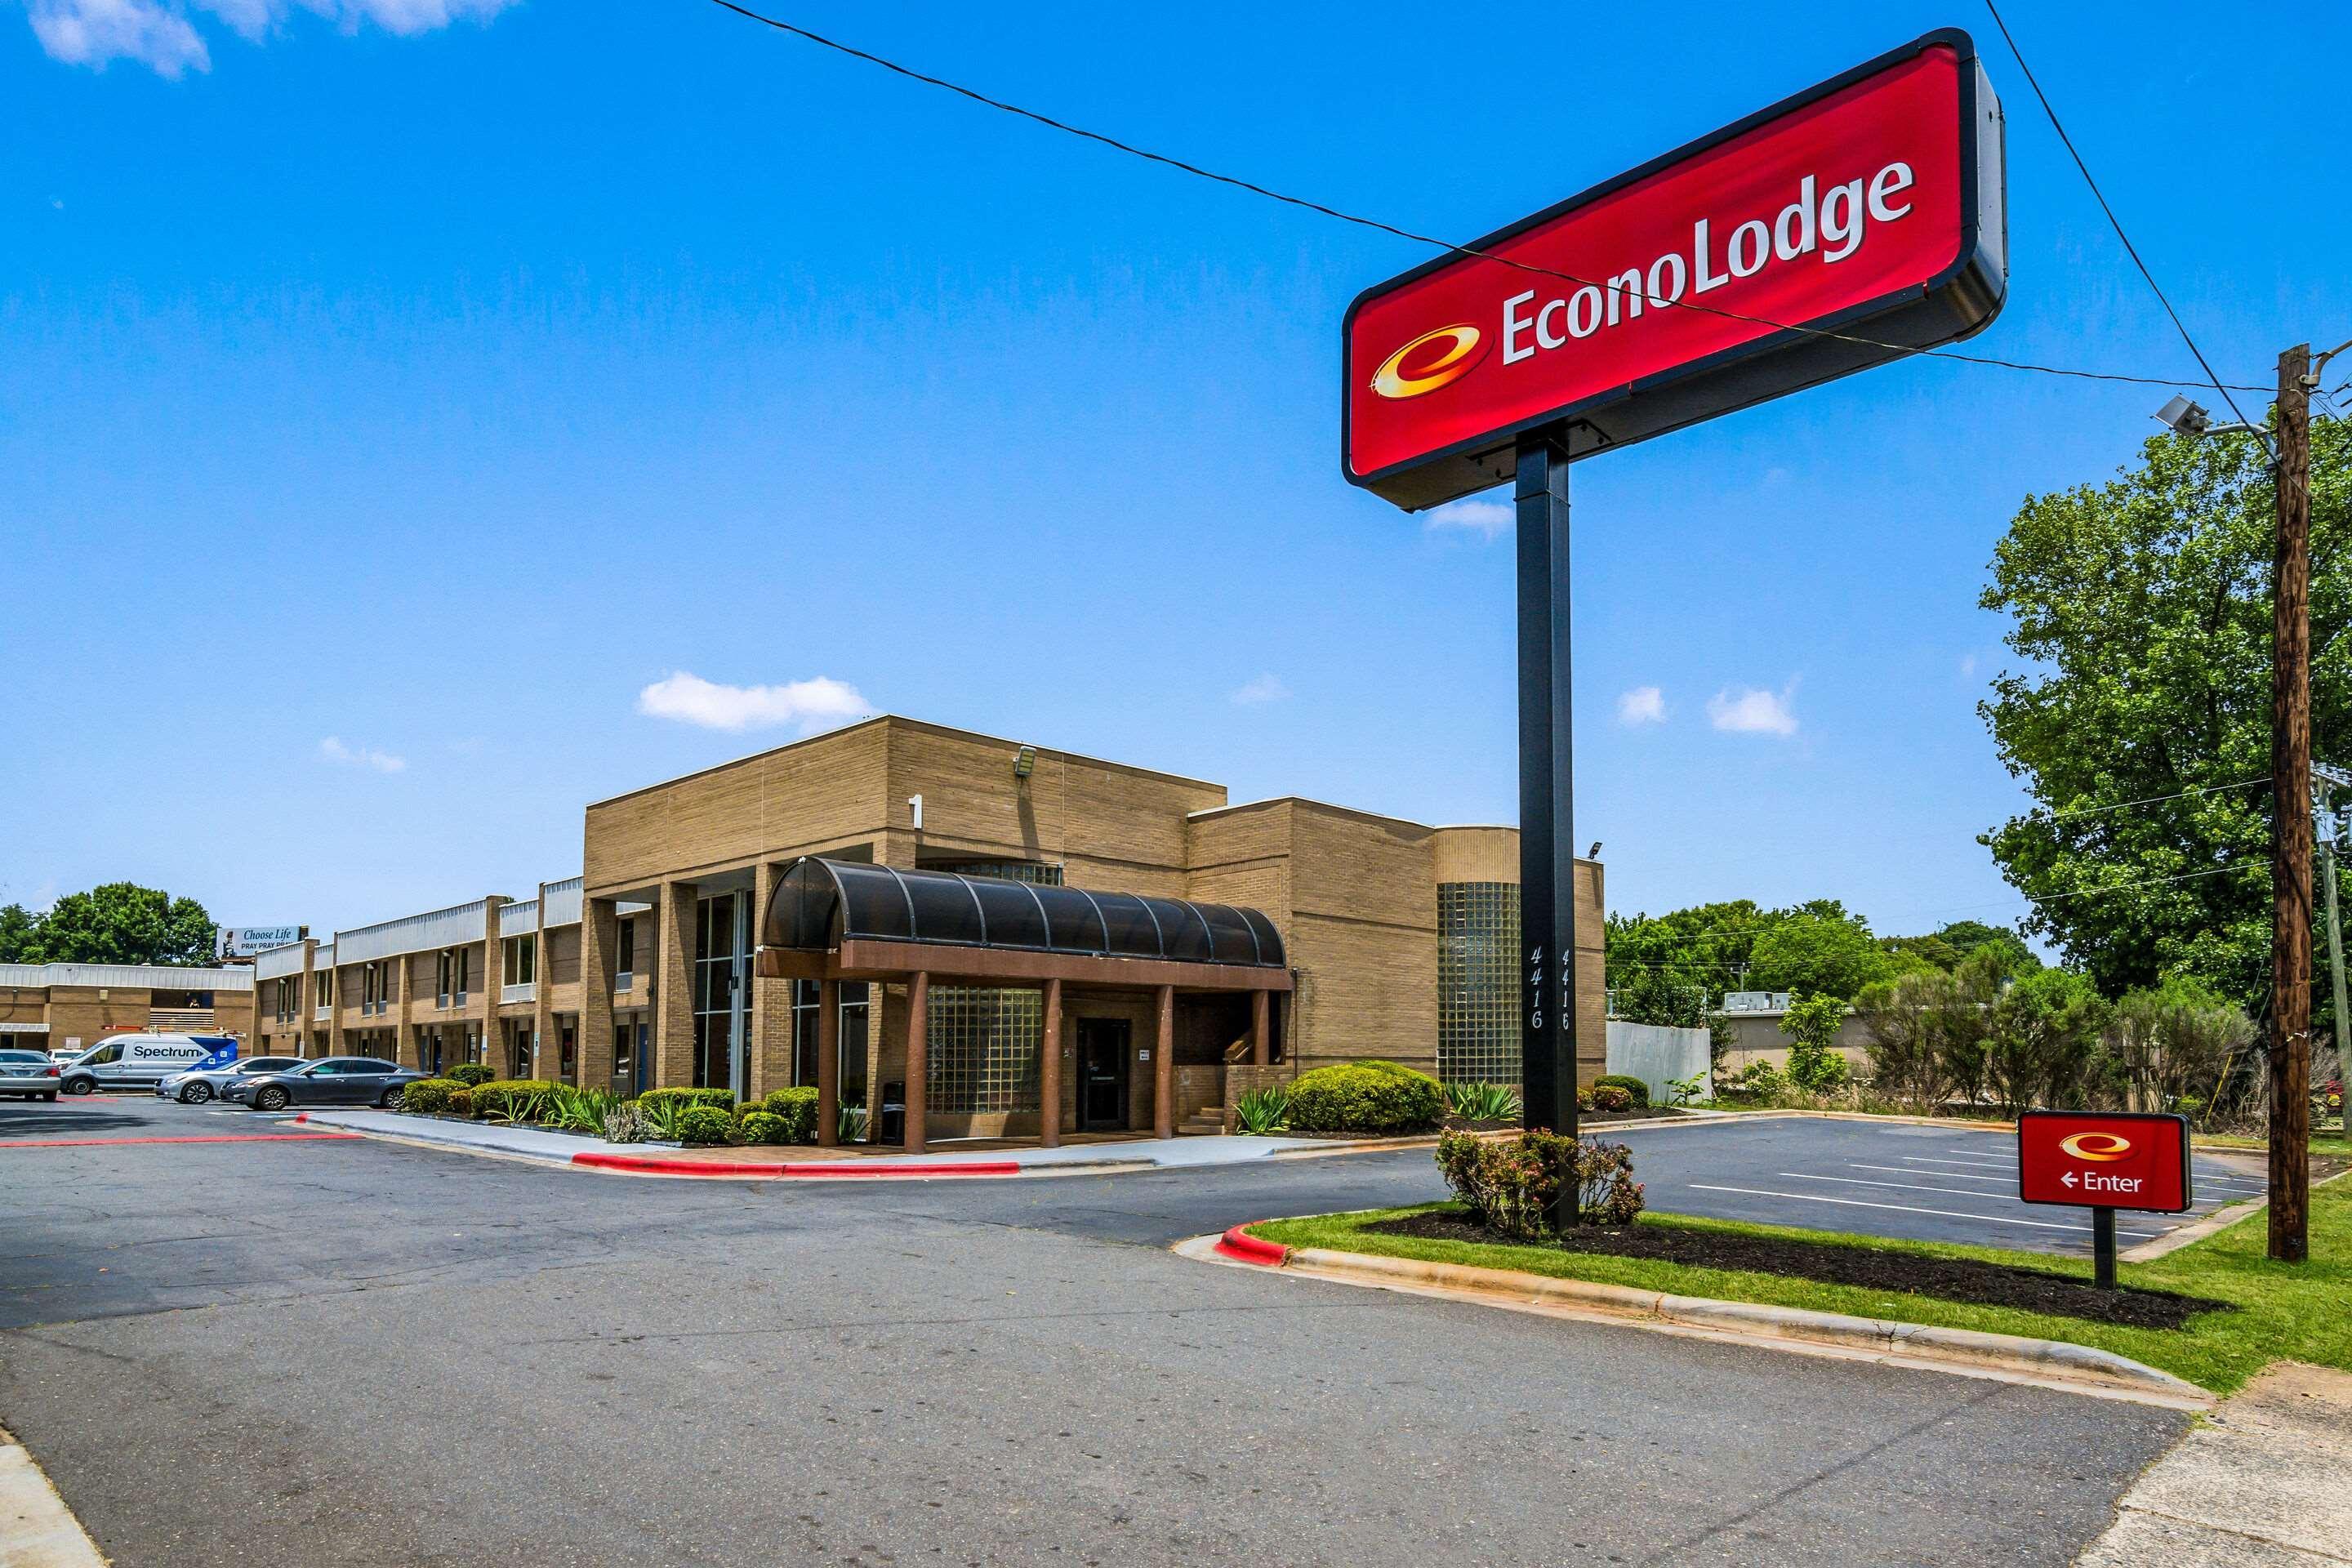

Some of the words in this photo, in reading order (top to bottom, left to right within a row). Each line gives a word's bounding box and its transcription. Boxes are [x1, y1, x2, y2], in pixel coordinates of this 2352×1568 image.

[1503, 161, 1914, 366] EconoLodge
[908, 794, 923, 829] 1
[243, 929, 273, 941] Choose
[275, 928, 292, 942] Life
[1530, 946, 1542, 1028] 4416
[134, 1045, 199, 1059] Spectrum
[2084, 1171, 2143, 1193] Enter
